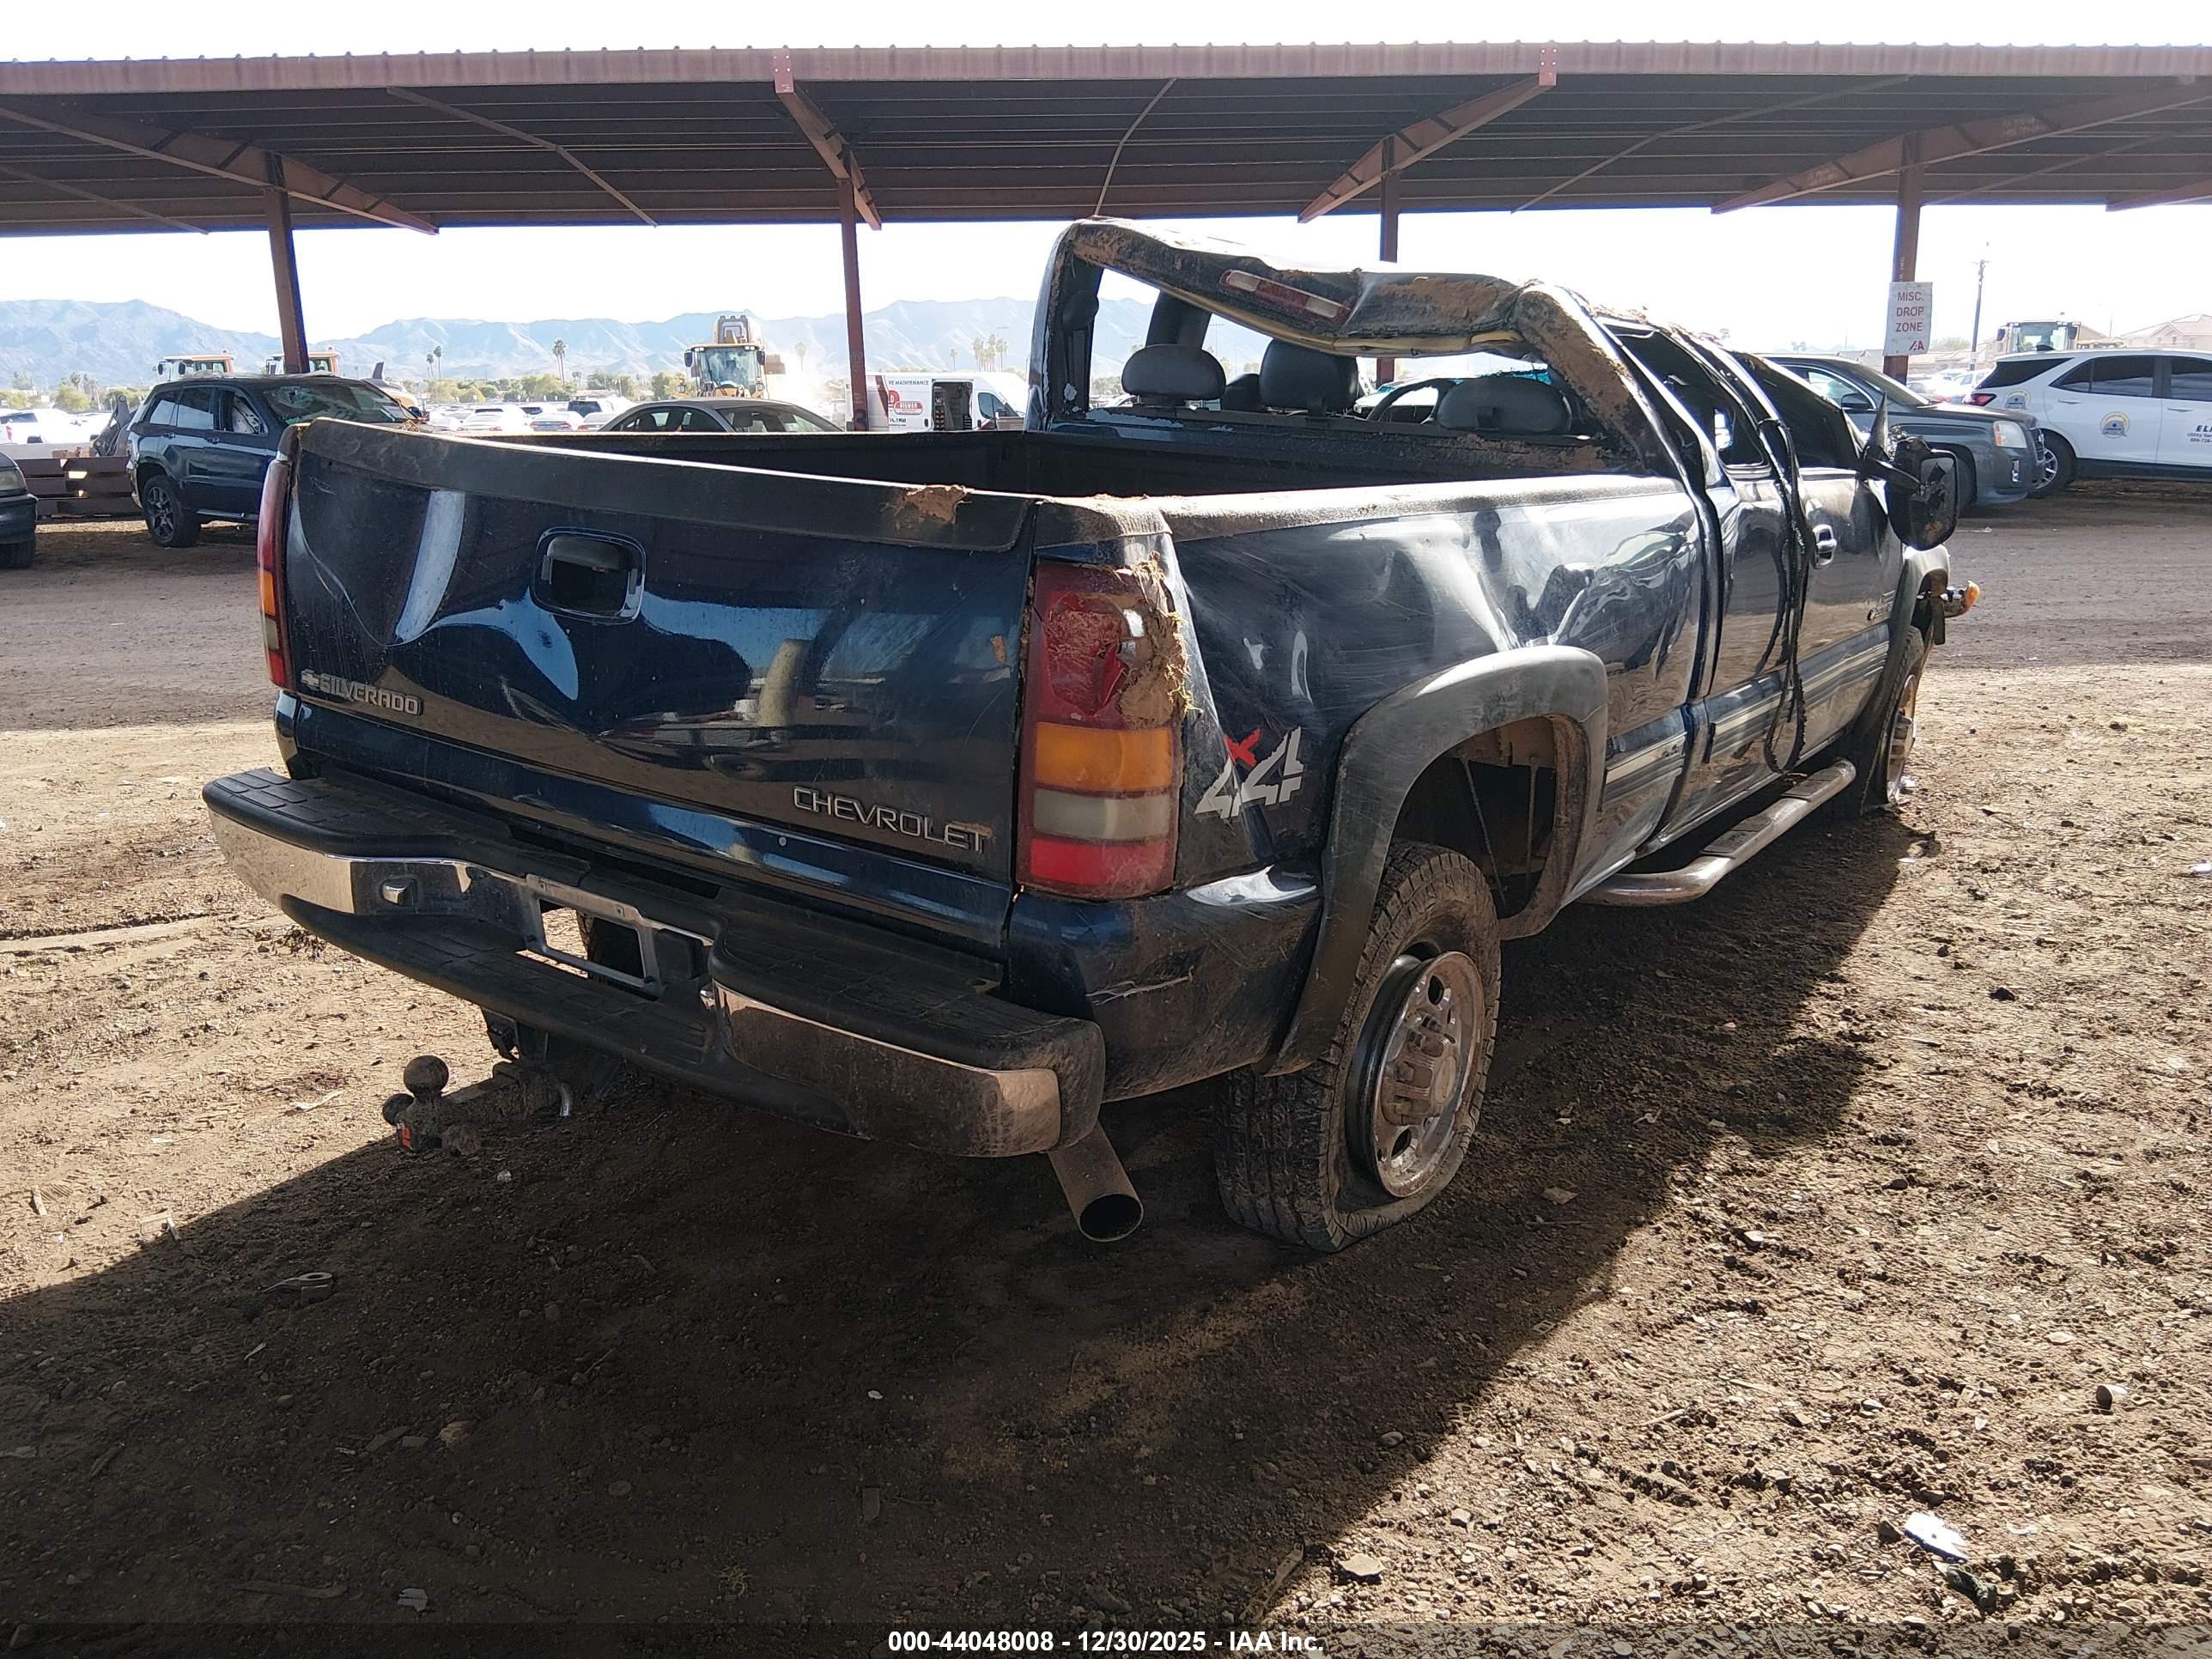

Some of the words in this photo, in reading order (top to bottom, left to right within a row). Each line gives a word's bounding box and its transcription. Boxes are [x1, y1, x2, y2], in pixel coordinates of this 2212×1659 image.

[1897, 291, 1924, 301] MISC.
[1896, 307, 1924, 317] DROP
[1895, 322, 1923, 332] ZONE
[319, 672, 421, 716] SILVERADO
[793, 786, 987, 854] CHEVROLET
